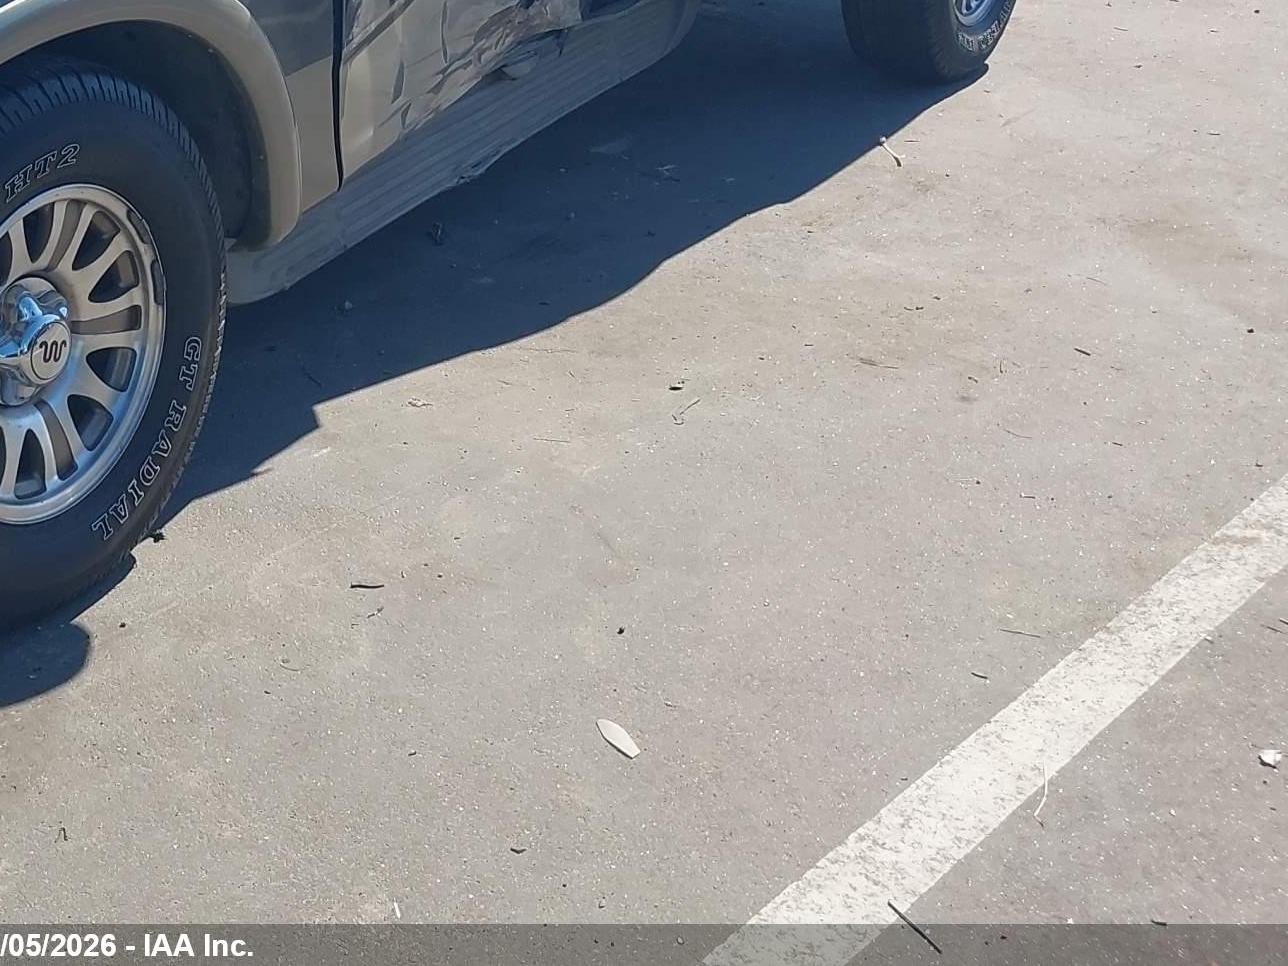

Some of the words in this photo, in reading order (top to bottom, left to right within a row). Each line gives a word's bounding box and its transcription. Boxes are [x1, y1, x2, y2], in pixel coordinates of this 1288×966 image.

[4, 143, 81, 204] HT2
[178, 336, 202, 391] GT
[91, 400, 187, 540] RADIAL
